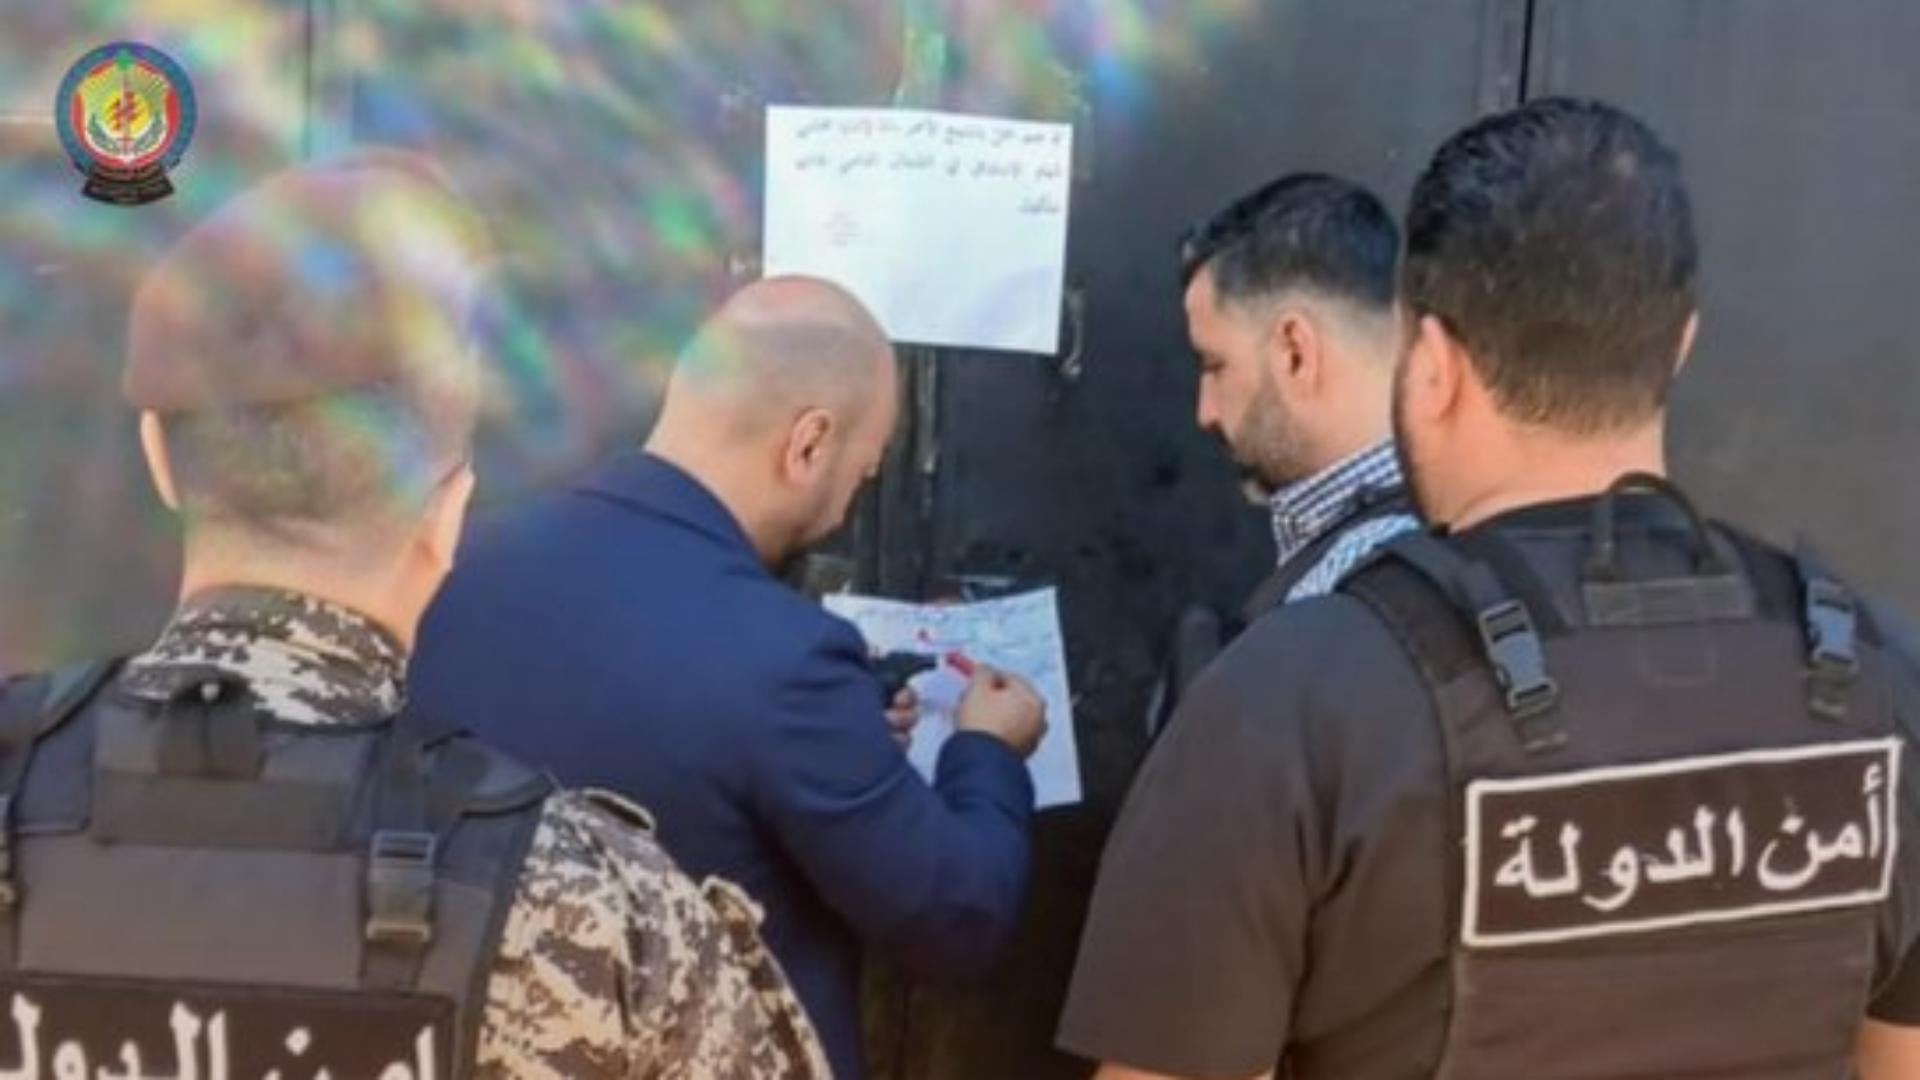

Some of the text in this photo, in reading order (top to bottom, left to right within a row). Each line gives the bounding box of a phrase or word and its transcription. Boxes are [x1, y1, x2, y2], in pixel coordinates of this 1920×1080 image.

[1494, 763, 1882, 912] أمن الدولة
[0, 993, 228, 1080] الدول
